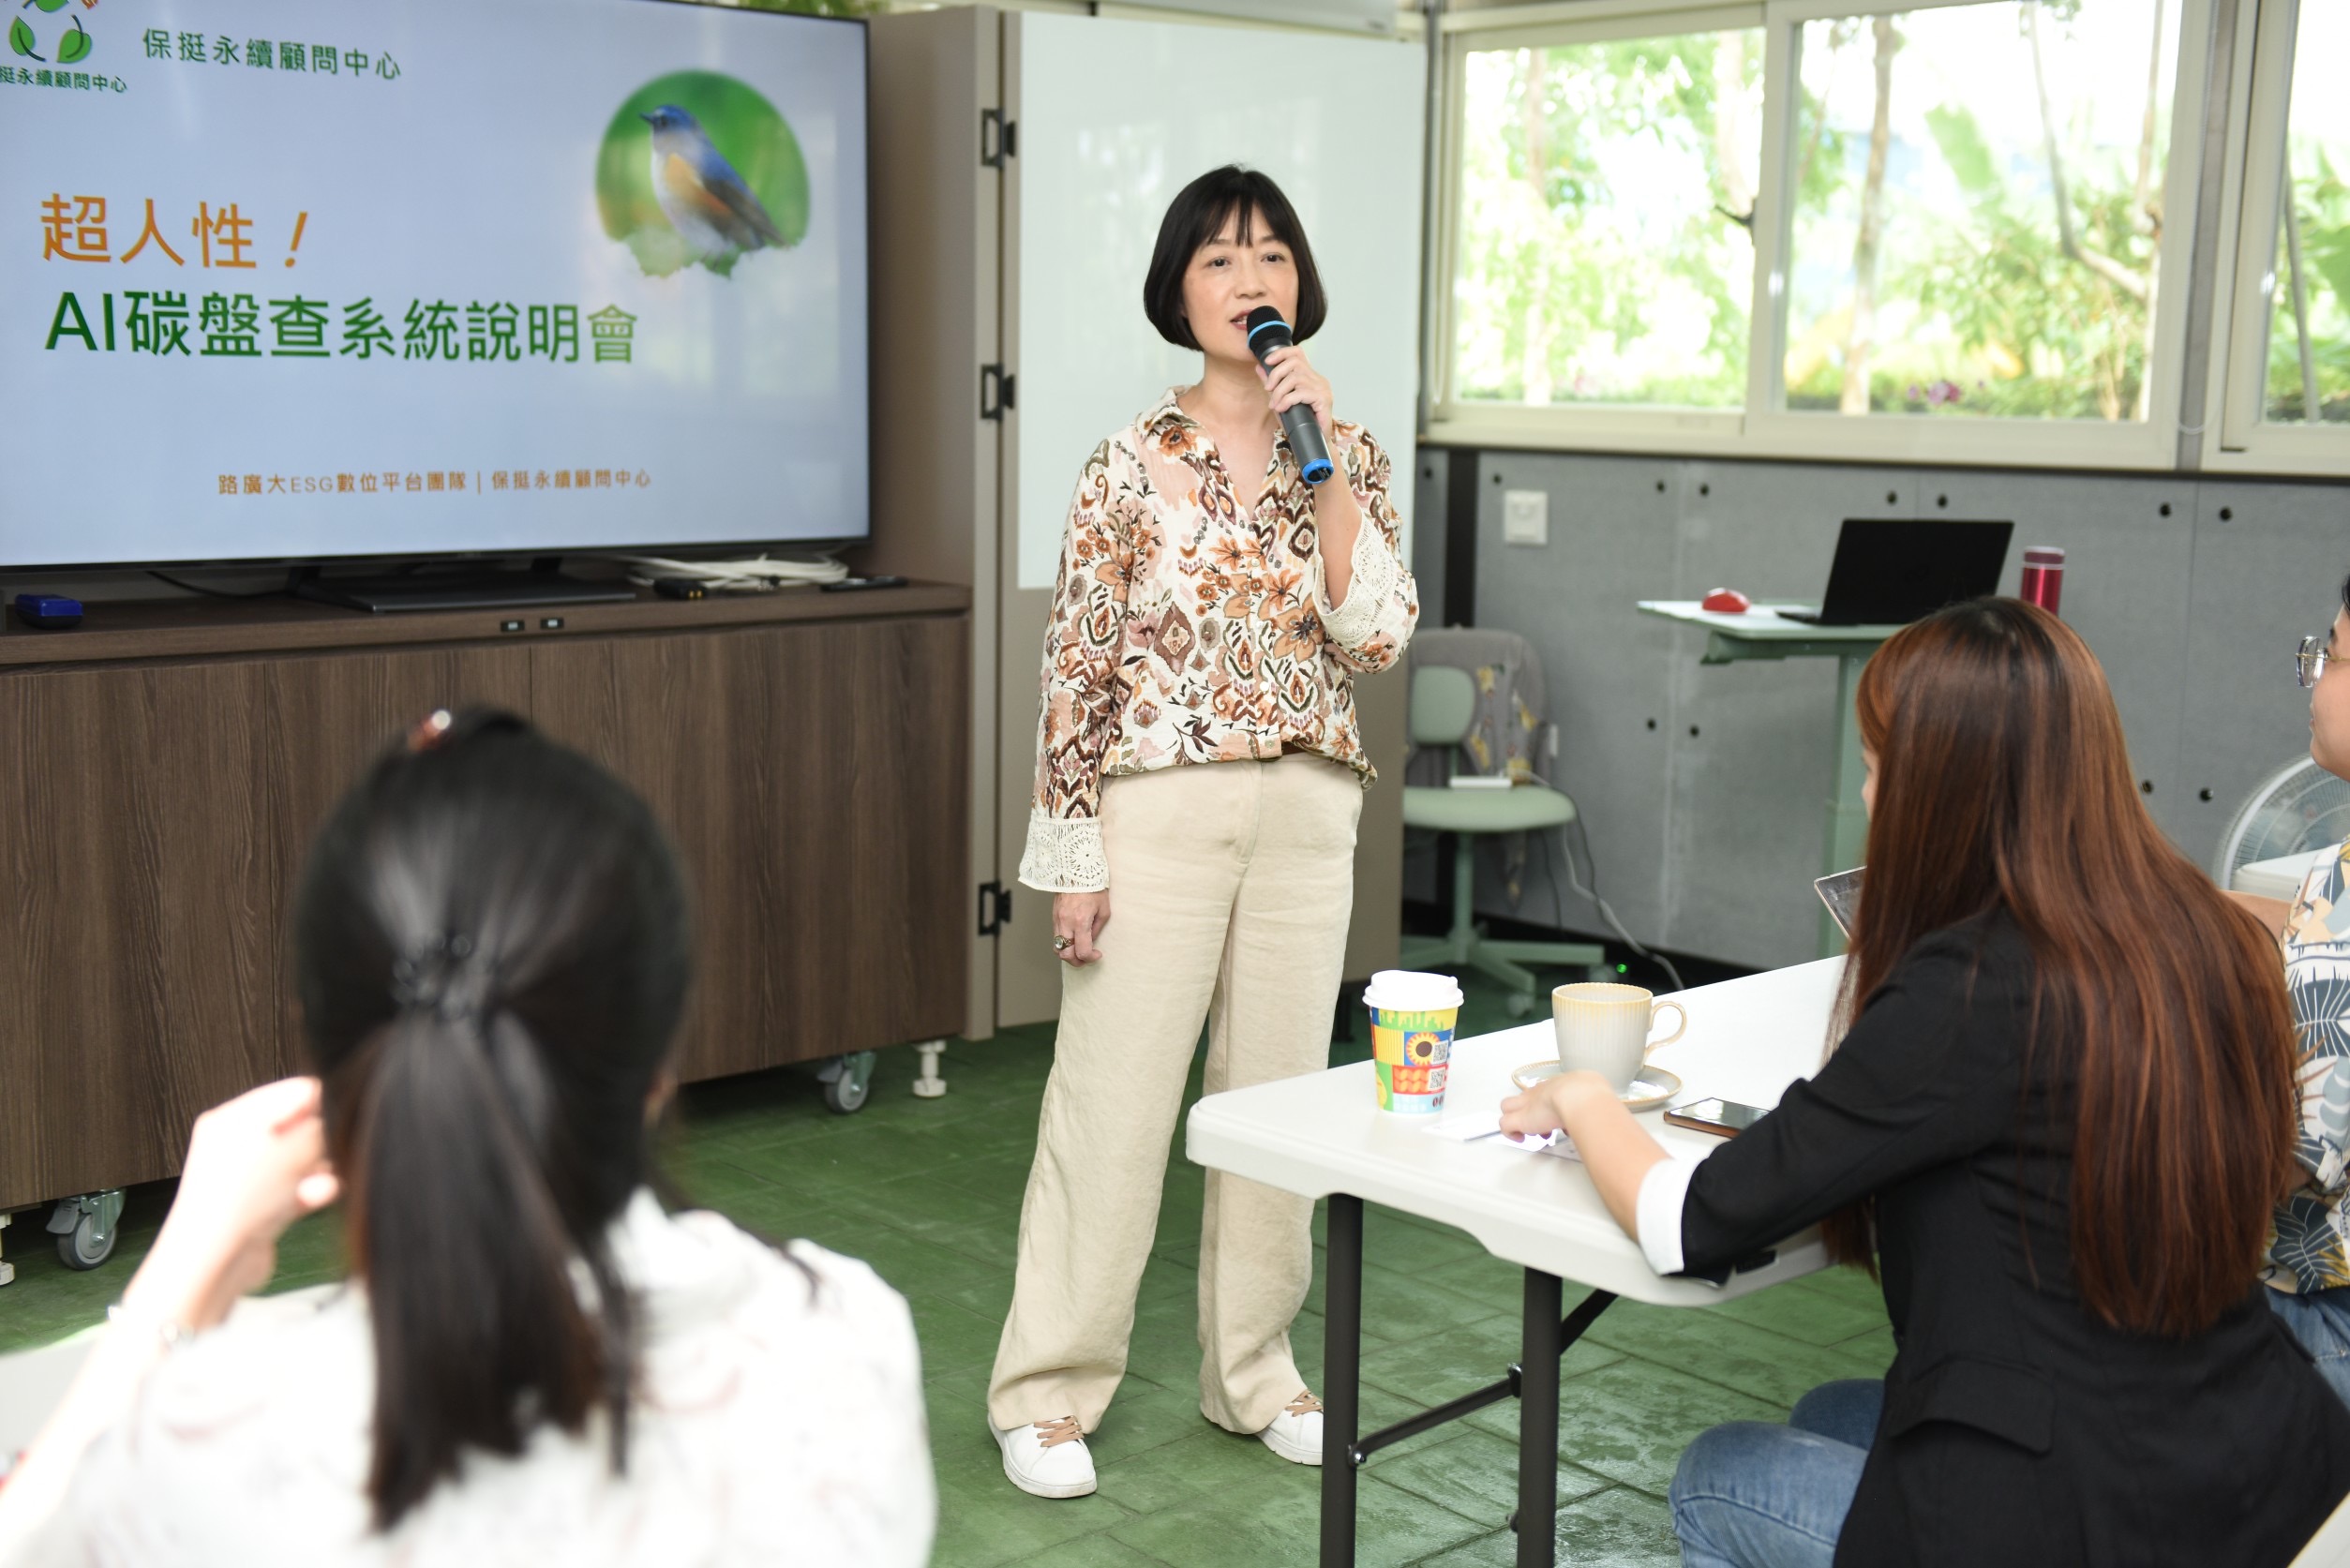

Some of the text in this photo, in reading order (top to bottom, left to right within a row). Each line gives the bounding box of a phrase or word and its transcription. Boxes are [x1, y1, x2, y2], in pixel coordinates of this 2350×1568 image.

[142, 28, 401, 81] 保挺永續顧問中心
[44, 291, 637, 364] AI碳盤查系統說明會
[492, 470, 651, 490] 保挺永續顧問中心
